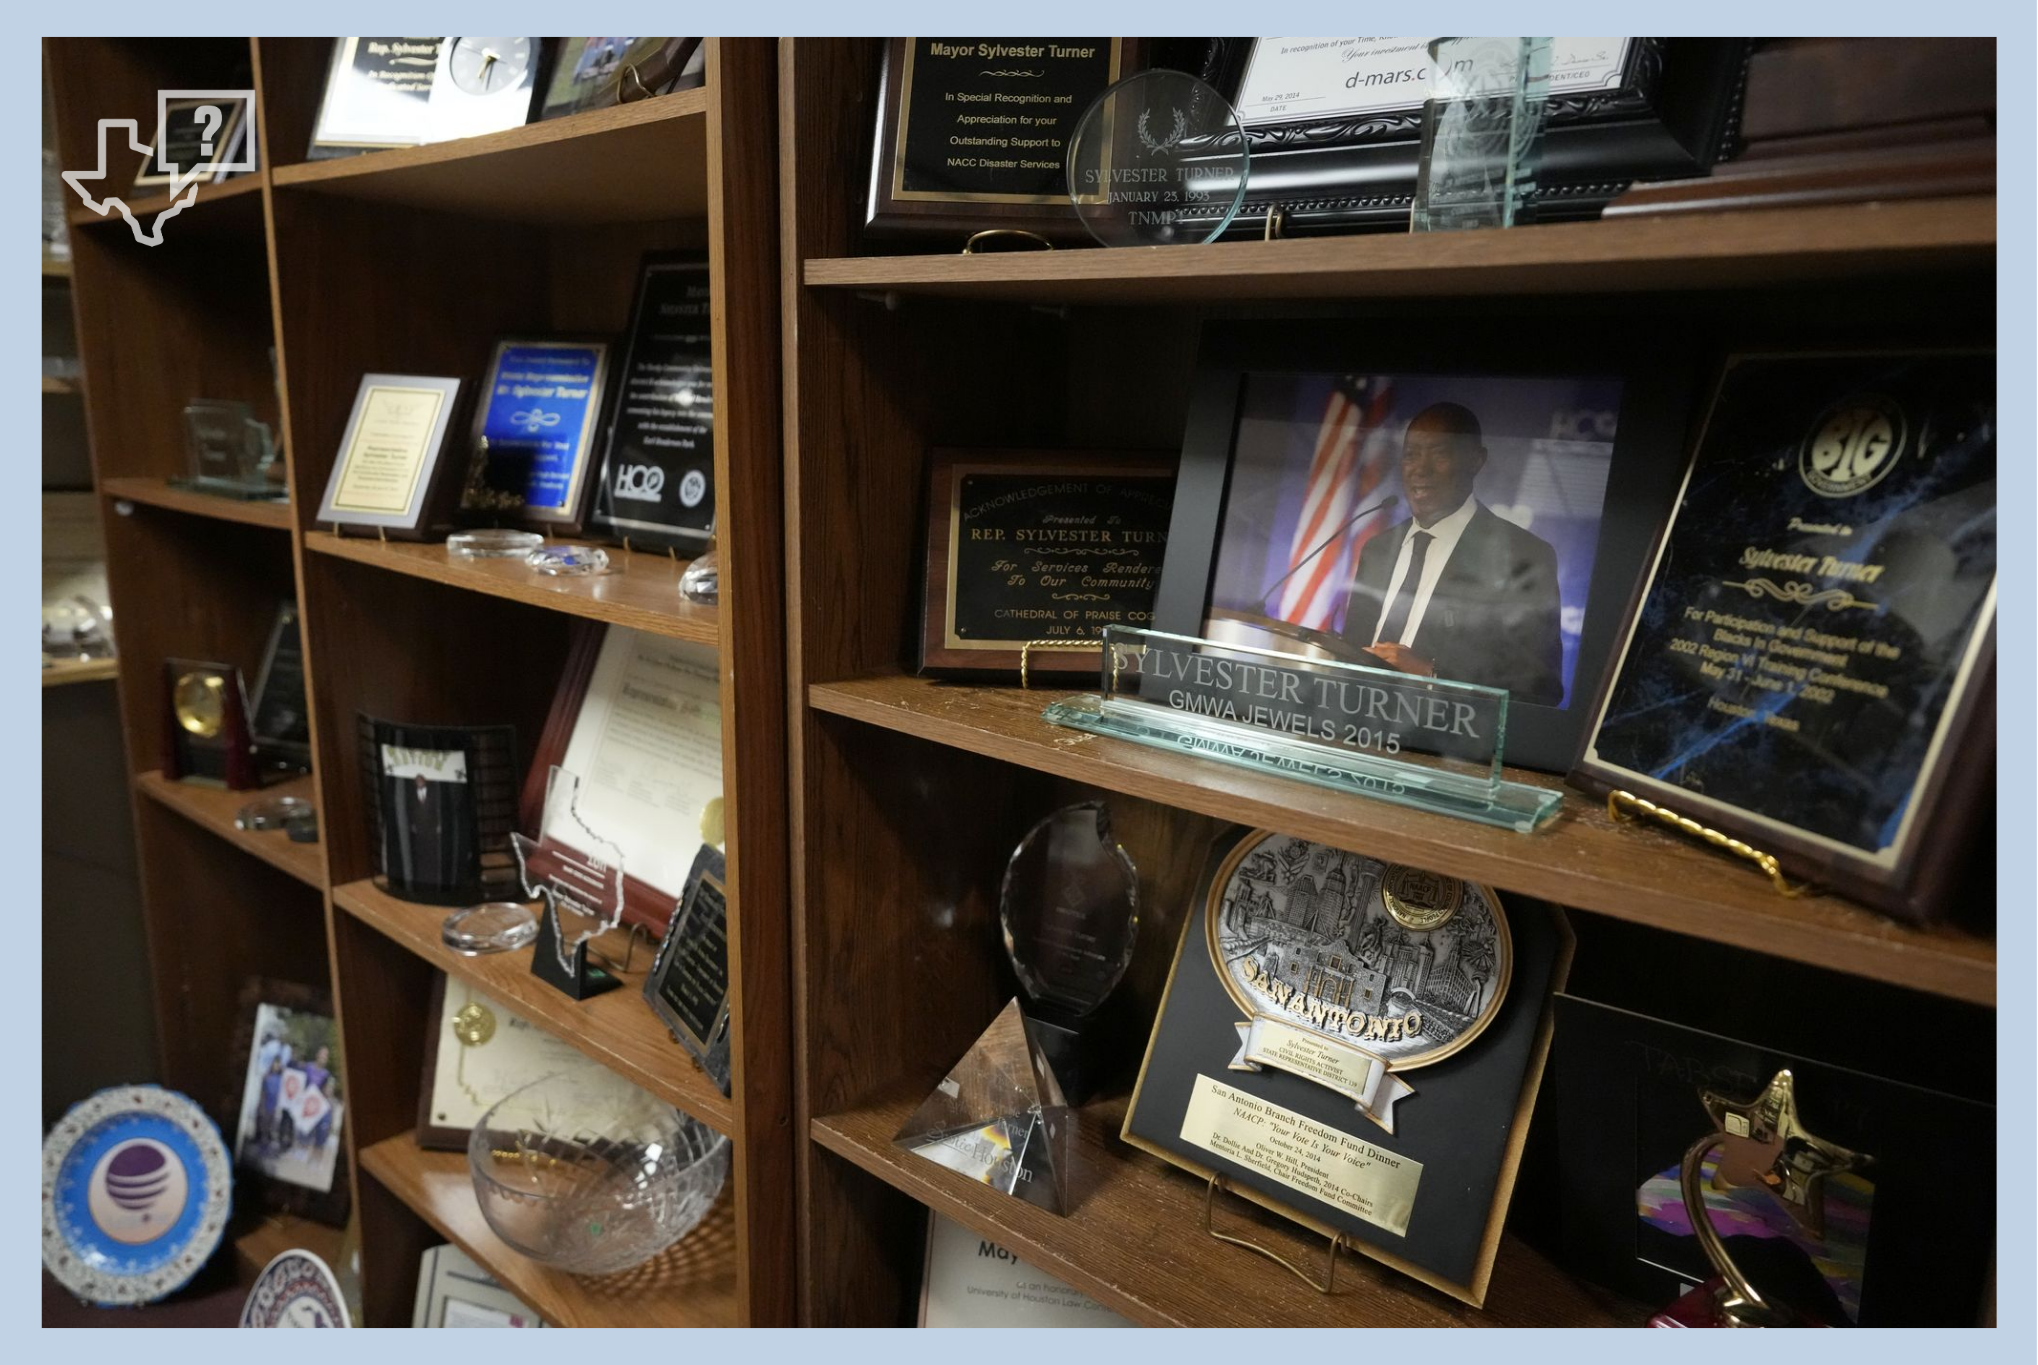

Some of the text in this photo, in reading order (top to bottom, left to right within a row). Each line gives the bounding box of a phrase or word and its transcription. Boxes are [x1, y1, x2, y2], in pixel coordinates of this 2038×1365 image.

[930, 42, 1095, 60] Mayor Sylvester Turner
[1289, 42, 1329, 54] recognition
[1330, 40, 1340, 48] of
[1339, 38, 1355, 46] your
[1341, 48, 1370, 63] Your
[945, 92, 1072, 105] In Special Recognition and
[1285, 92, 1300, 100] 2014
[957, 114, 1057, 127] Appreciation for your
[950, 136, 1061, 149] Outstanding Support to
[947, 158, 1060, 169] NACC Disaster Services
[1085, 167, 1168, 184] SYLVESTER
[1108, 191, 1159, 204] JANUARY
[1812, 408, 1893, 482] BIG
[963, 483, 1112, 522] ACKNOWLEDGEMENT OF
[1042, 514, 1122, 525] Presented To
[970, 529, 1006, 541] REP.
[1016, 529, 1112, 542] SYLVESTER
[991, 560, 1017, 573] For
[1031, 560, 1089, 573] Services
[1739, 546, 1886, 584] Sylvester Turner
[1007, 575, 1155, 590] To Our Community
[994, 609, 1057, 620] CATHEDRAL
[1063, 610, 1079, 620] OF
[1085, 610, 1121, 621] PRAISE
[1046, 626, 1085, 637] JULY 6,
[1684, 606, 1902, 660] For Participation and Support of the
[1713, 628, 1752, 647] Blacks
[1768, 639, 1849, 669] Government
[1669, 637, 1699, 655] 2002
[1699, 643, 1740, 664] Region
[1757, 656, 1808, 682] Training
[1809, 667, 1890, 700] Conference
[1114, 642, 1480, 739] SYLVESTER TURNER
[1700, 660, 1726, 680] May
[1726, 667, 1743, 681] 31
[1751, 673, 1784, 692] June
[1799, 683, 1836, 704] 2002
[1169, 689, 1400, 755] GMWA JEWELS 2015
[1242, 954, 1424, 1042] SAN ANTONIO
[1278, 1046, 1344, 1075] CIVIL RIGHTS ACTIVIST
[1286, 1039, 1340, 1065] Sylvester Turner
[1263, 1047, 1278, 1058] STATE
[1278, 1053, 1321, 1075] REPRESENTATIVE
[1322, 1069, 1348, 1084] DISTRICT
[1211, 1084, 1402, 1169] San Antonio Branch Freedom Fund Dinner
[1233, 1107, 1372, 1169] NAACP: "Your Vote Is Your Voice"
[1256, 1142, 1330, 1179] Oliver W. Hill, President
[1269, 1136, 1322, 1163] October 24, 2014
[1209, 1139, 1373, 1216] Mentoria L. Sherfield, Chair Freedom Fund Committee
[1212, 1132, 1374, 1208] Dr. Dollie And Dr. Gregory Hudspeth, 2014 Co-Chairs
[967, 1286, 1009, 1300] University
[1011, 1290, 1021, 1300] of
[1022, 1292, 1061, 1306] Houston
[1062, 1298, 1082, 1309] Law
